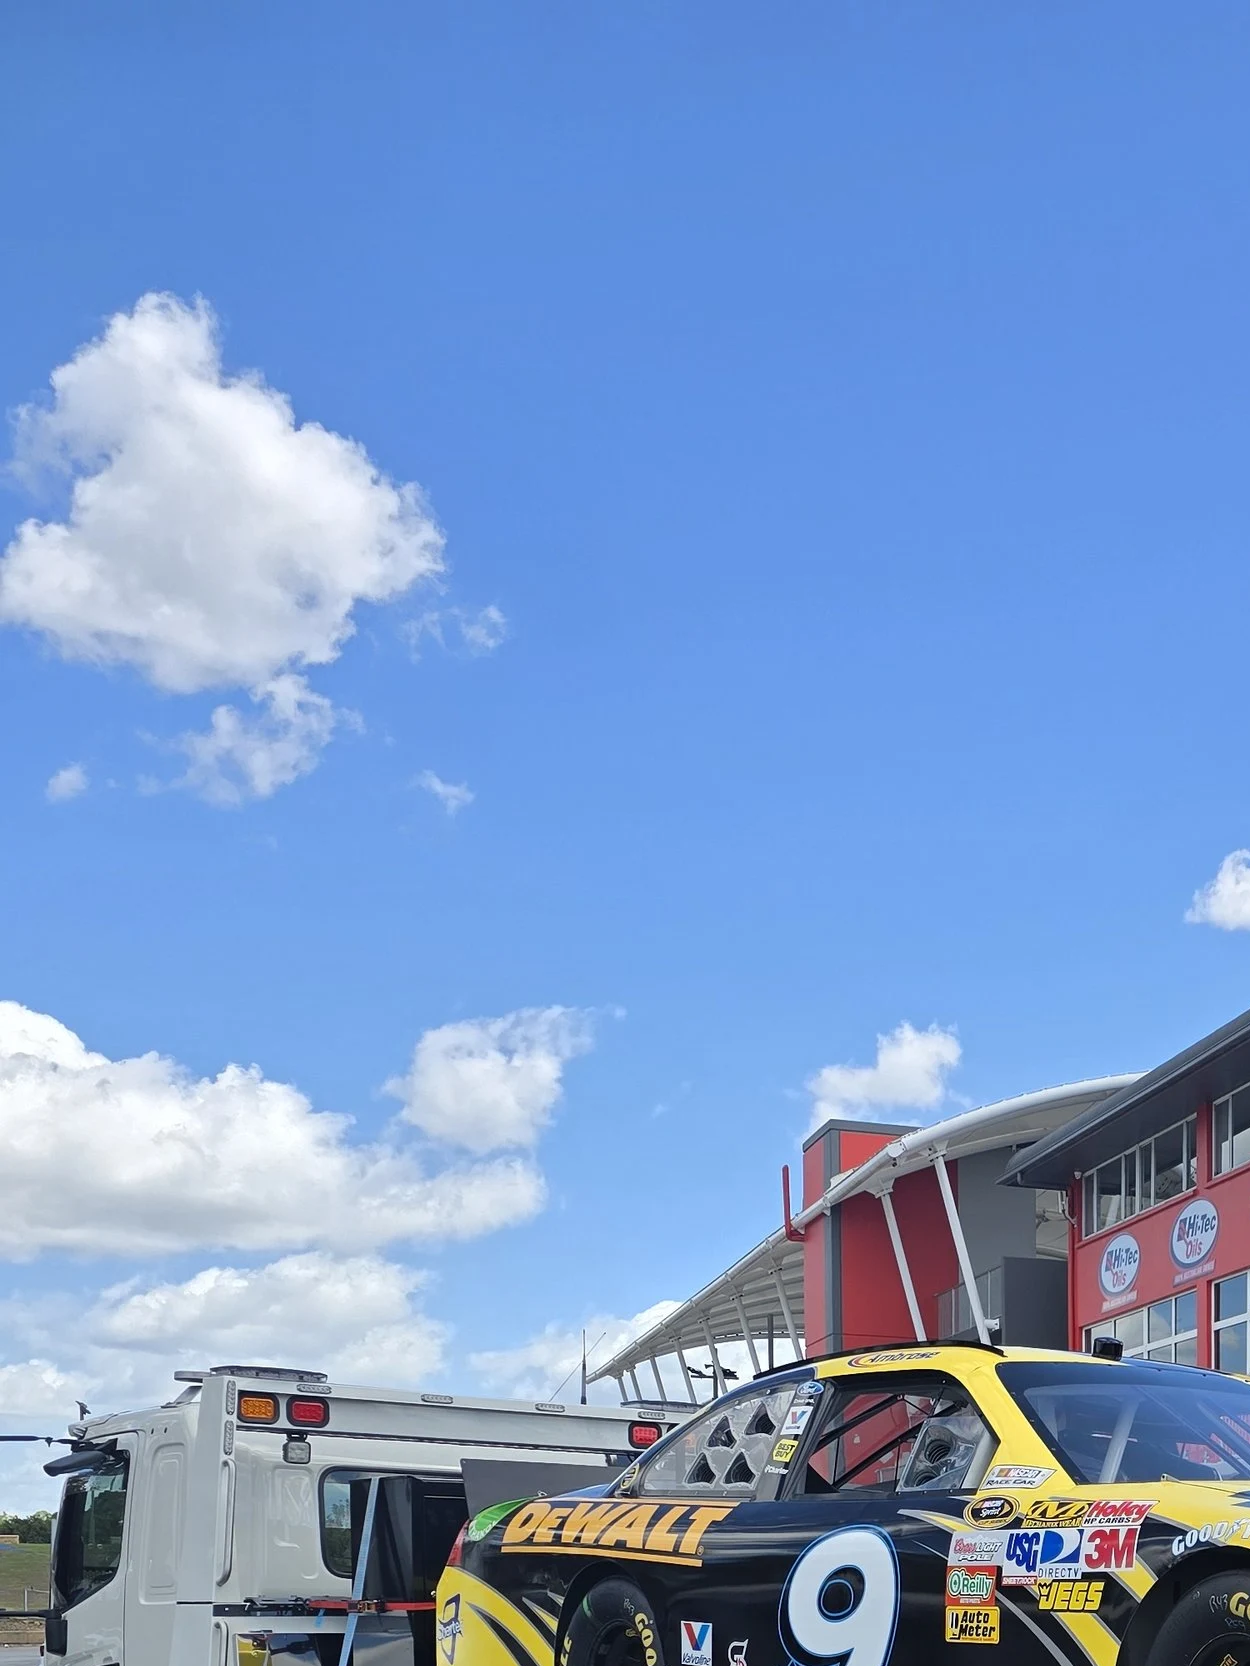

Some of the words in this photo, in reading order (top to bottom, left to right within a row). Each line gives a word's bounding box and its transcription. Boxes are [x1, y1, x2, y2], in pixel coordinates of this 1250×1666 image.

[1187, 1213, 1216, 1239] Hi-Tec
[1186, 1238, 1203, 1260] Oils
[1112, 1247, 1138, 1270] Hi-Tec
[1017, 1478, 1036, 1486] CAR
[1084, 1517, 1097, 1525] HP
[1098, 1516, 1132, 1525] CARBS
[976, 1541, 1003, 1553] LIGHT
[1006, 1531, 1041, 1573] USG
[1085, 1528, 1138, 1569] 3M
[958, 1554, 993, 1562] POLE
[1039, 1567, 1081, 1579] DIRECTV
[948, 1569, 994, 1599] O'Reilly
[1039, 1581, 1105, 1611] JEGS
[961, 1611, 990, 1623] Auto
[959, 1624, 996, 1638] Meter
[682, 1652, 712, 1666] Valvoline
